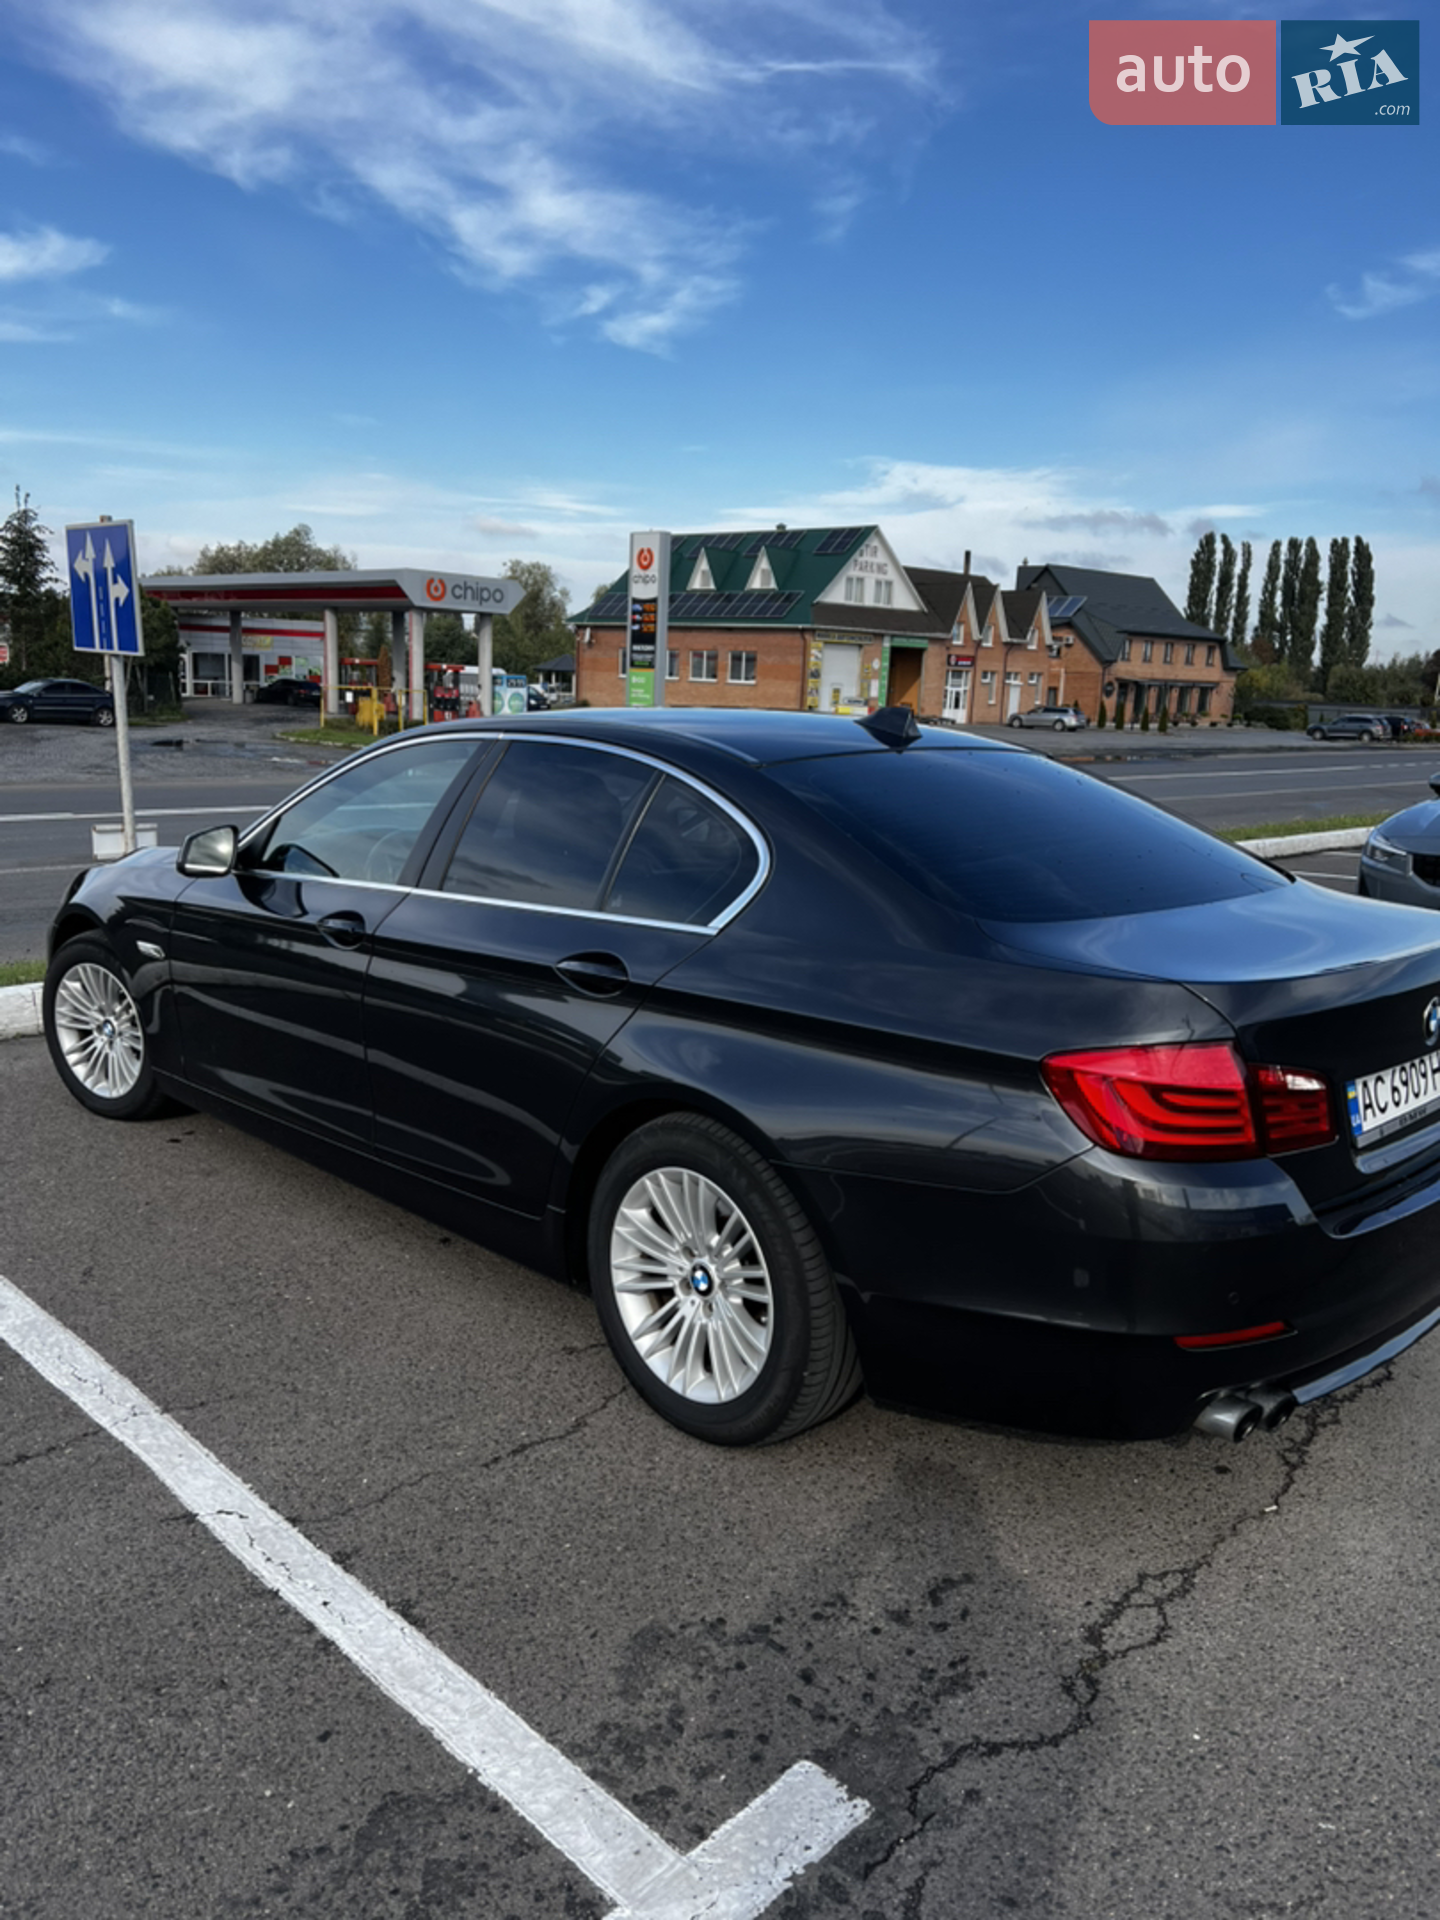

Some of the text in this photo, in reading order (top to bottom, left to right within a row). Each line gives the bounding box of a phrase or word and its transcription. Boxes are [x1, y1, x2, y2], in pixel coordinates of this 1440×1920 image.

[852, 559, 888, 576] PARKING
[632, 573, 657, 585] chipo
[450, 580, 505, 606] chipo
